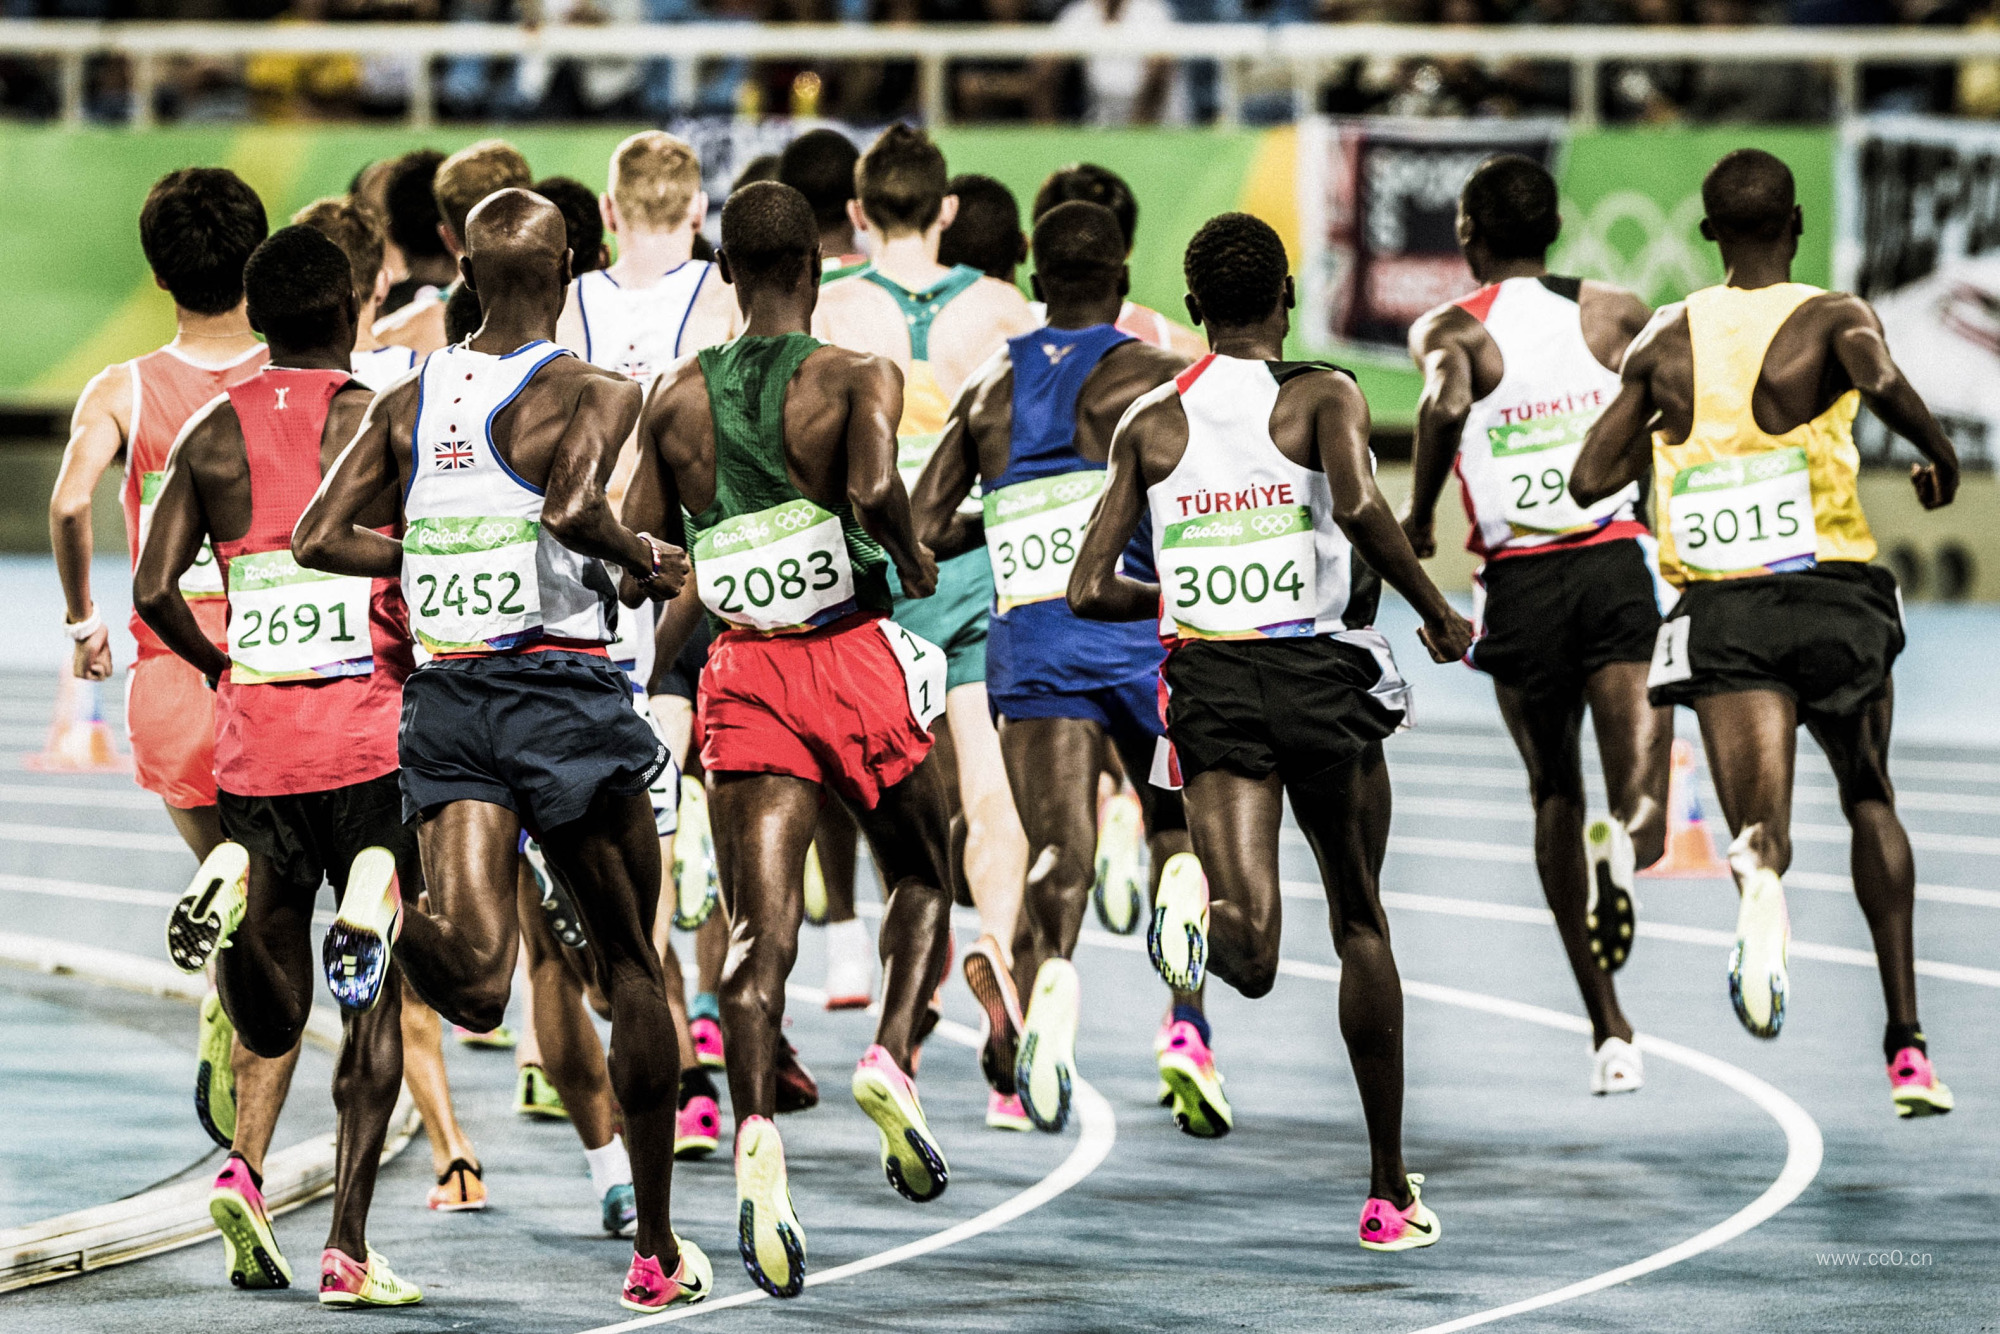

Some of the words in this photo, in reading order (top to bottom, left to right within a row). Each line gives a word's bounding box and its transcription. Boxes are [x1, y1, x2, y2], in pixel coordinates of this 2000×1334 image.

[1176, 483, 1294, 516] TÜRKİYE
[418, 527, 468, 546] Rio2016
[1684, 501, 1799, 549] 3015
[998, 524, 1086, 579] 308
[417, 571, 525, 617] 2452
[713, 550, 839, 613] 2083
[1174, 560, 1305, 608] 3004
[238, 602, 355, 649] 2691
[900, 628, 926, 662] 1
[919, 680, 931, 716] 1
